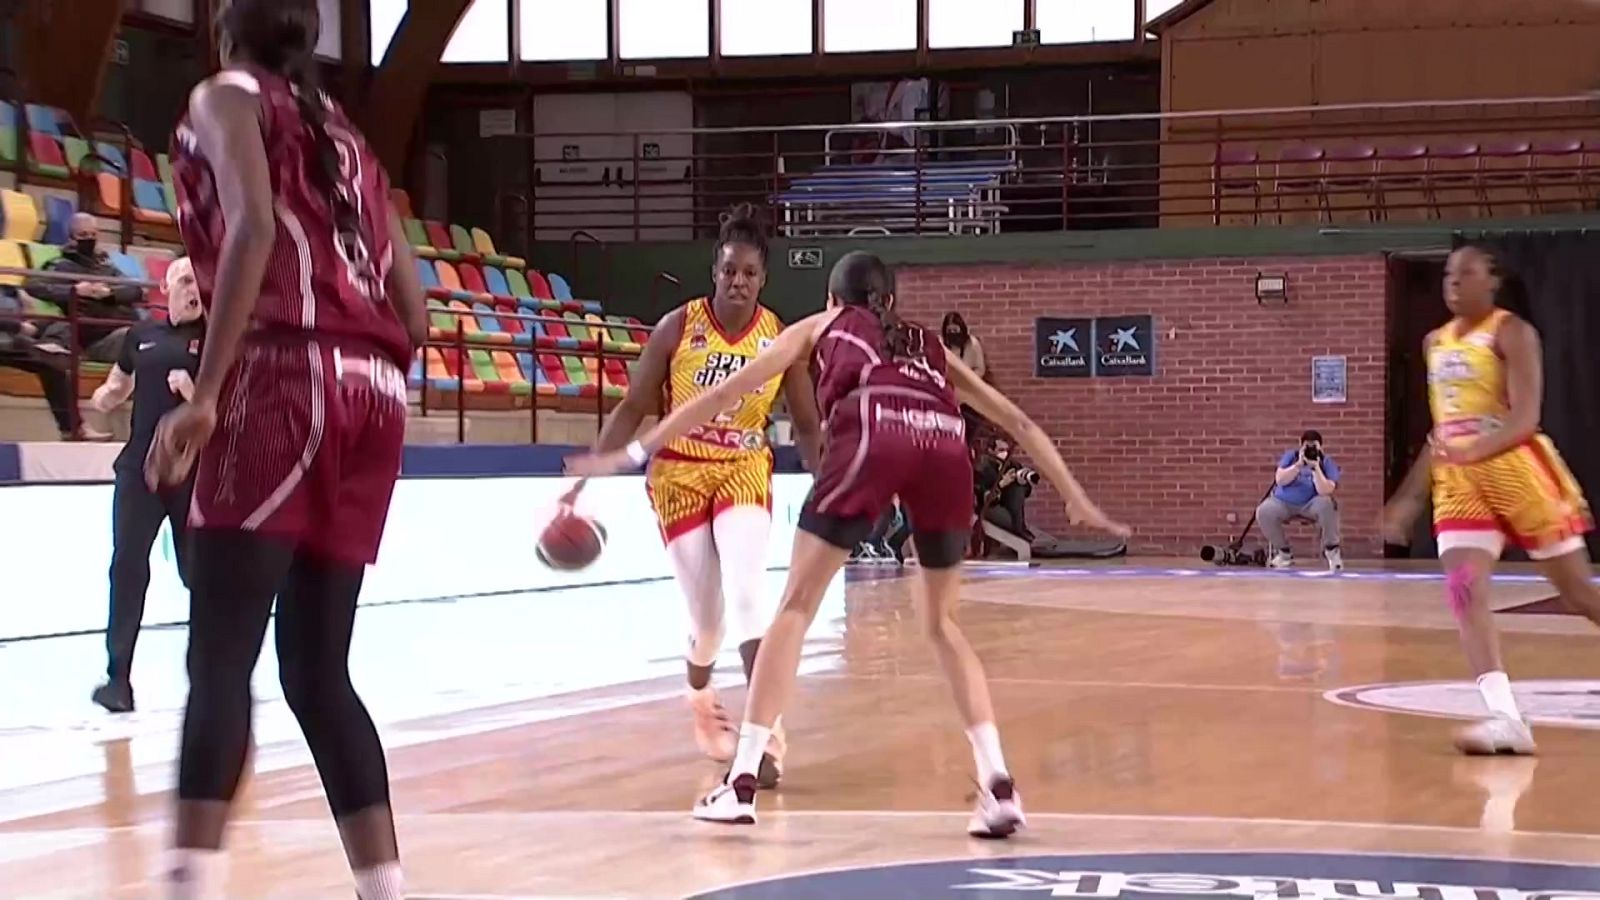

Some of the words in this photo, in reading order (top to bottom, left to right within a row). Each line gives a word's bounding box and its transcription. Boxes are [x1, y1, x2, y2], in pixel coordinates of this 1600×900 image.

[706, 352, 750, 372] SPA
[1041, 355, 1086, 367] CaixaBank
[1101, 354, 1147, 366] CaixaBank
